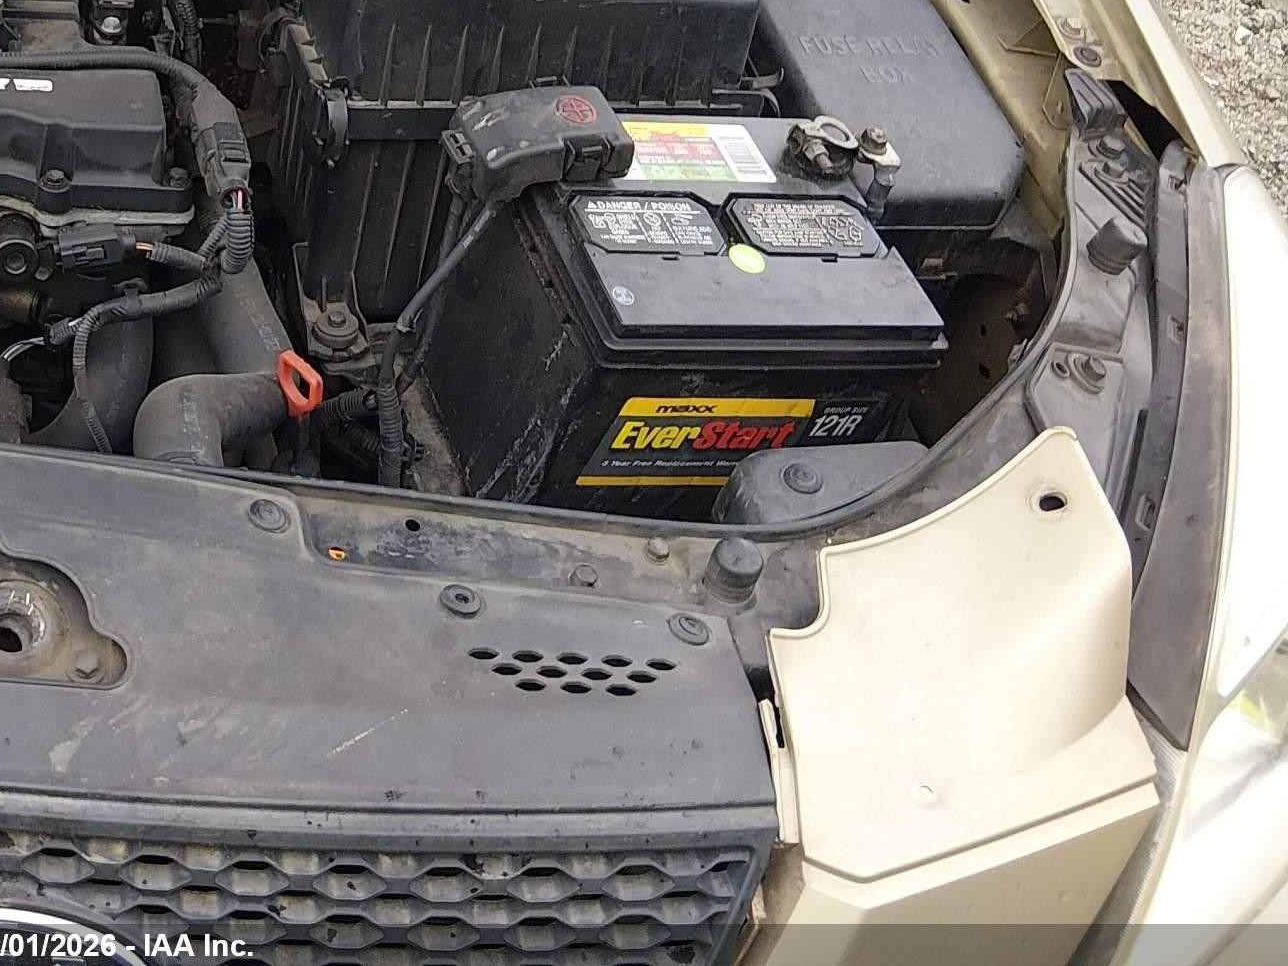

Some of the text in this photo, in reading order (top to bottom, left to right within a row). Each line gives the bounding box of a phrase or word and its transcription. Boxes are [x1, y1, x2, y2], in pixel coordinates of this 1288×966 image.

[797, 34, 942, 57] FUSE RELAY
[858, 65, 913, 83] BOX
[596, 200, 642, 210] DANGER
[650, 201, 691, 212] POISON
[655, 404, 718, 414] maxx
[823, 406, 851, 414] GROUP
[808, 414, 863, 437] 121R
[610, 420, 797, 451] EverStart
[611, 459, 631, 467] Year
[632, 459, 653, 467] Free
[654, 459, 714, 469] Replacement
